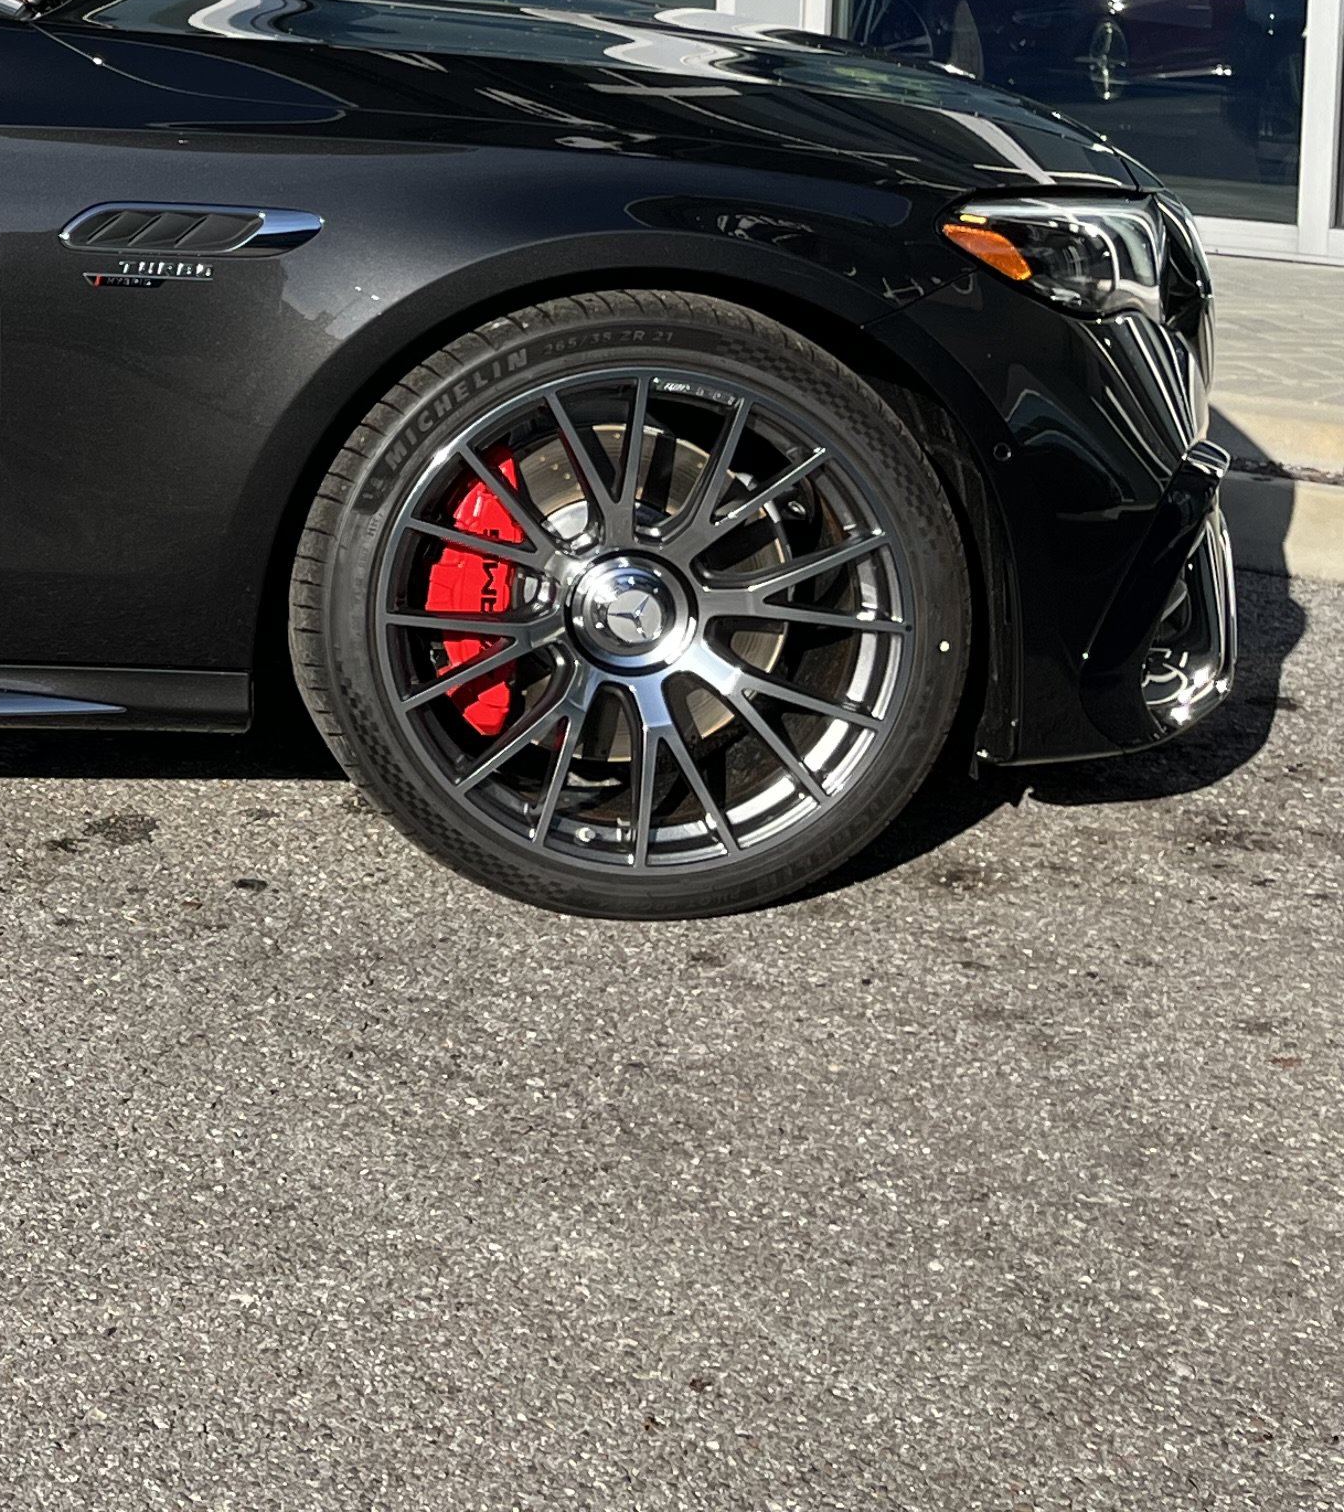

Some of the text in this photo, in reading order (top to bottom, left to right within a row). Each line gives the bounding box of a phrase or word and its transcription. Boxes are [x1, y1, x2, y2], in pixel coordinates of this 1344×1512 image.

[383, 346, 529, 472] MICHELIN
[542, 331, 613, 356] 265/35
[652, 330, 674, 343] 21
